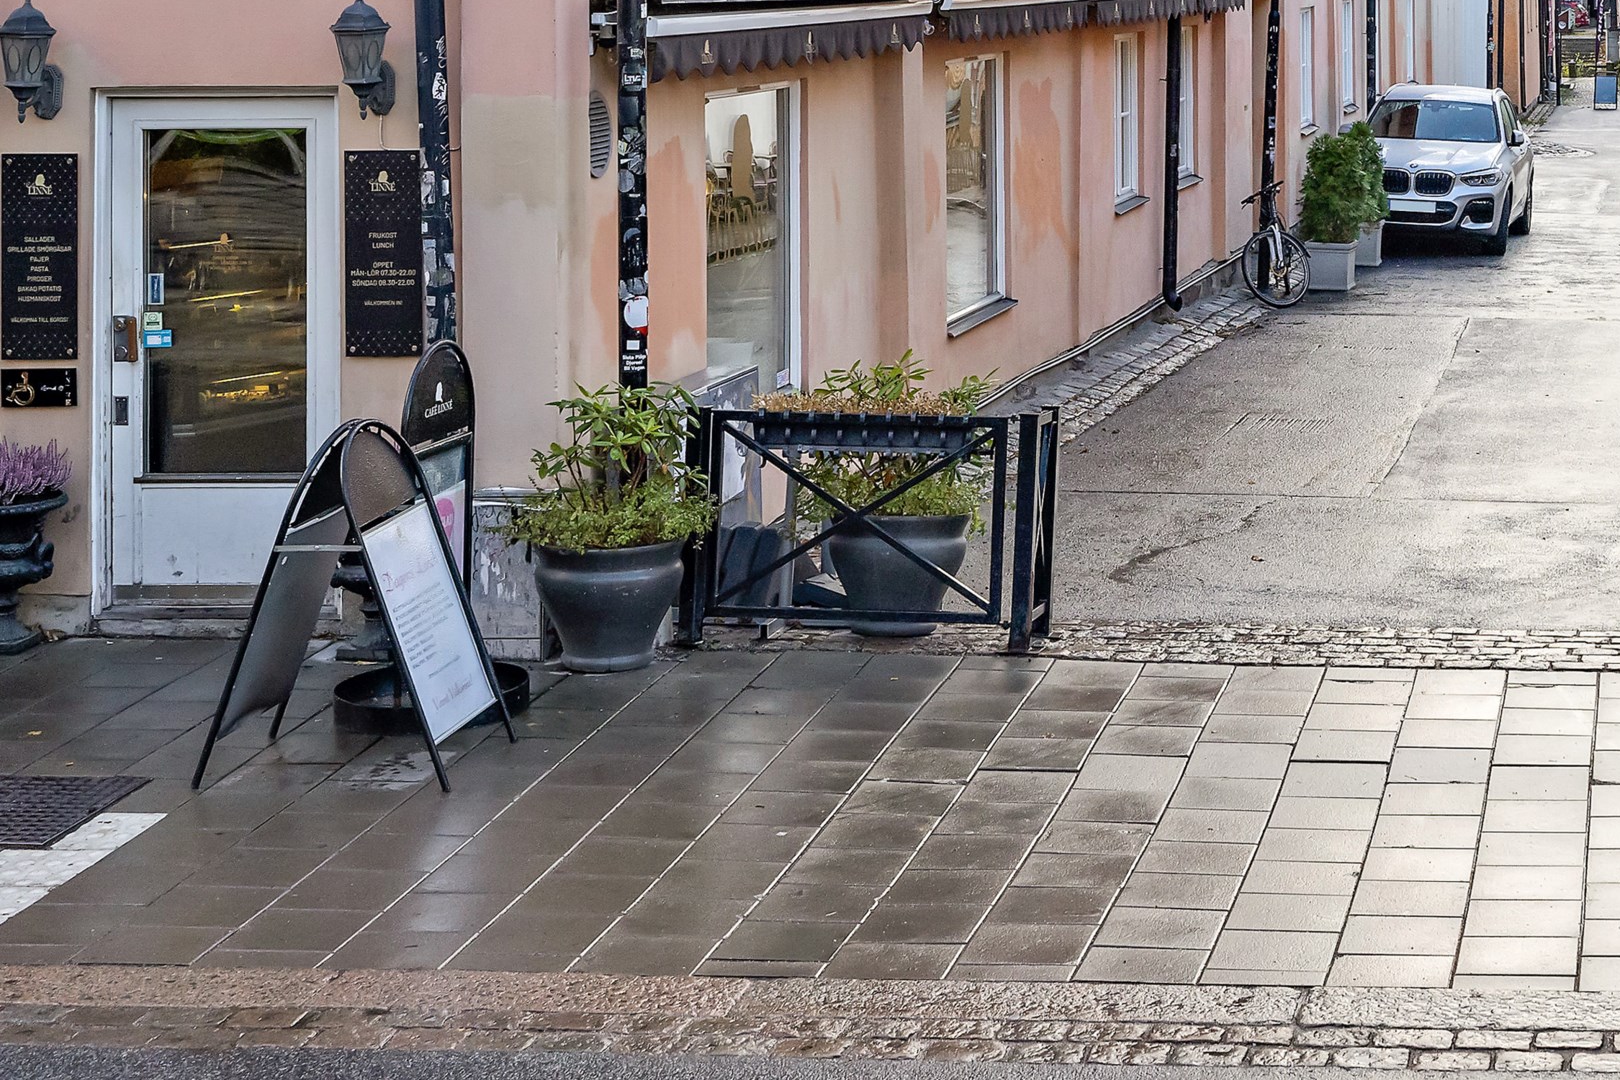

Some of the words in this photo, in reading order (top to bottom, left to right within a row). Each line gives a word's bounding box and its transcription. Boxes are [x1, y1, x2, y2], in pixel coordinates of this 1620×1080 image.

[372, 261, 394, 269] ÖPPET
[350, 268, 379, 277] MÅN-LÖR
[424, 404, 438, 419] CAFÉ
